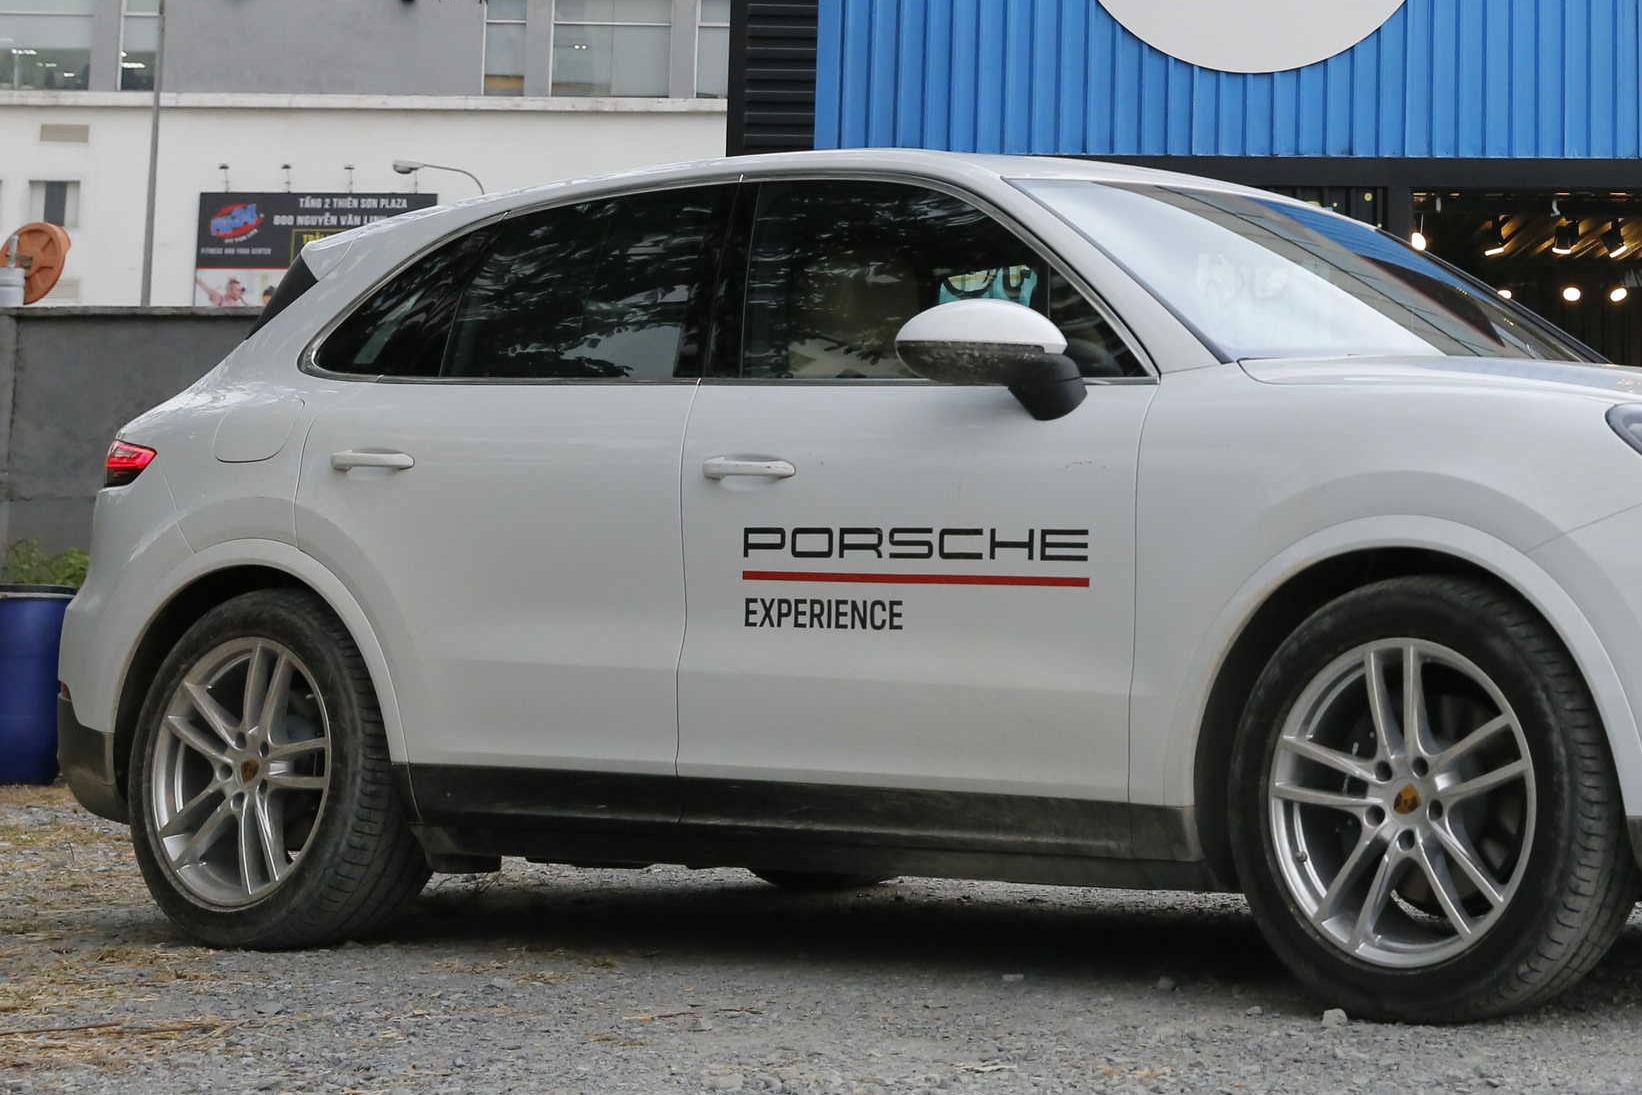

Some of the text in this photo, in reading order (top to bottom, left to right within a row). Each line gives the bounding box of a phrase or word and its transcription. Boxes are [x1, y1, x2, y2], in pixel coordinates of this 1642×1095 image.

[324, 198, 331, 209] 2
[379, 198, 408, 209] PLAZA
[340, 213, 361, 226] VĂN
[743, 527, 1089, 561] PORSCHE
[744, 597, 903, 630] EXPERIENCE
